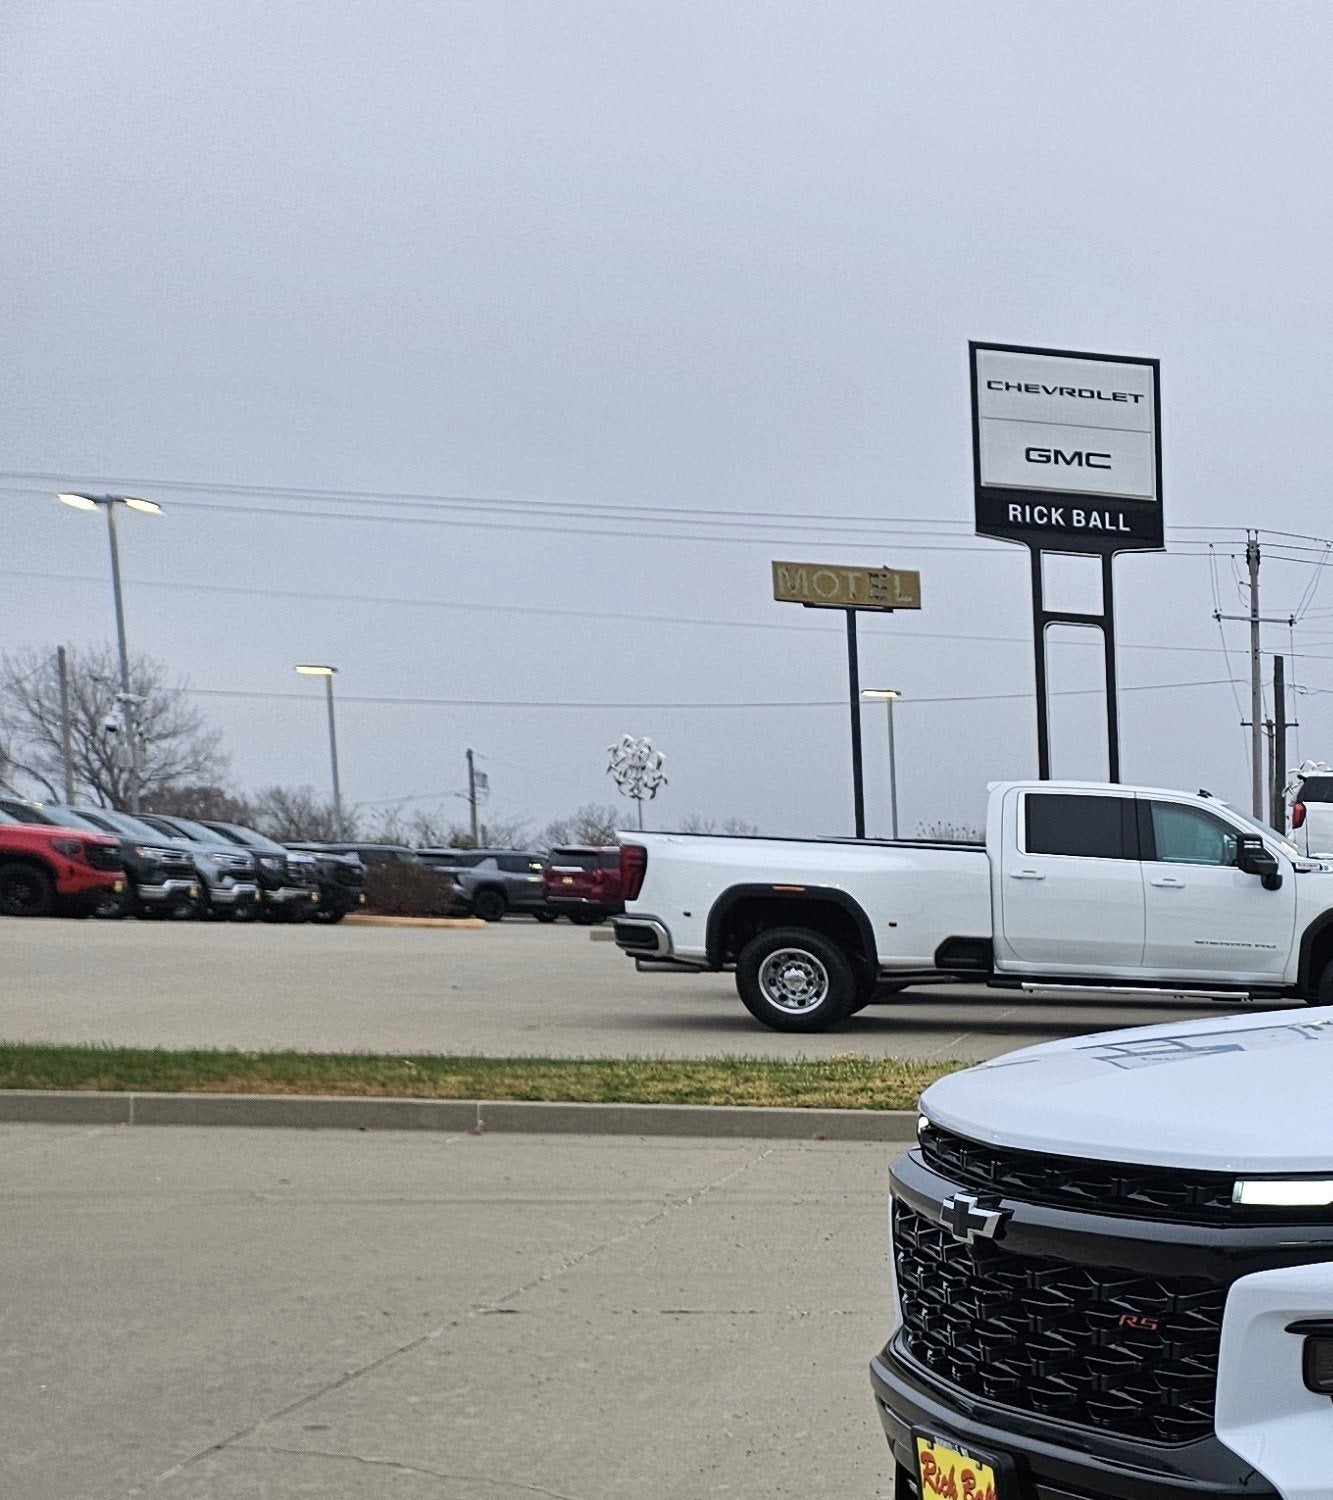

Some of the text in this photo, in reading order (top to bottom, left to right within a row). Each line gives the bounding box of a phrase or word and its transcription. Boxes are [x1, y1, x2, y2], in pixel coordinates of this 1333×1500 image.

[986, 379, 1144, 404] CHEVROLET
[1024, 446, 1112, 470] GMC
[1008, 503, 1131, 532] RICK BALL
[777, 566, 912, 602] MOTEL
[1118, 1314, 1158, 1330] RS
